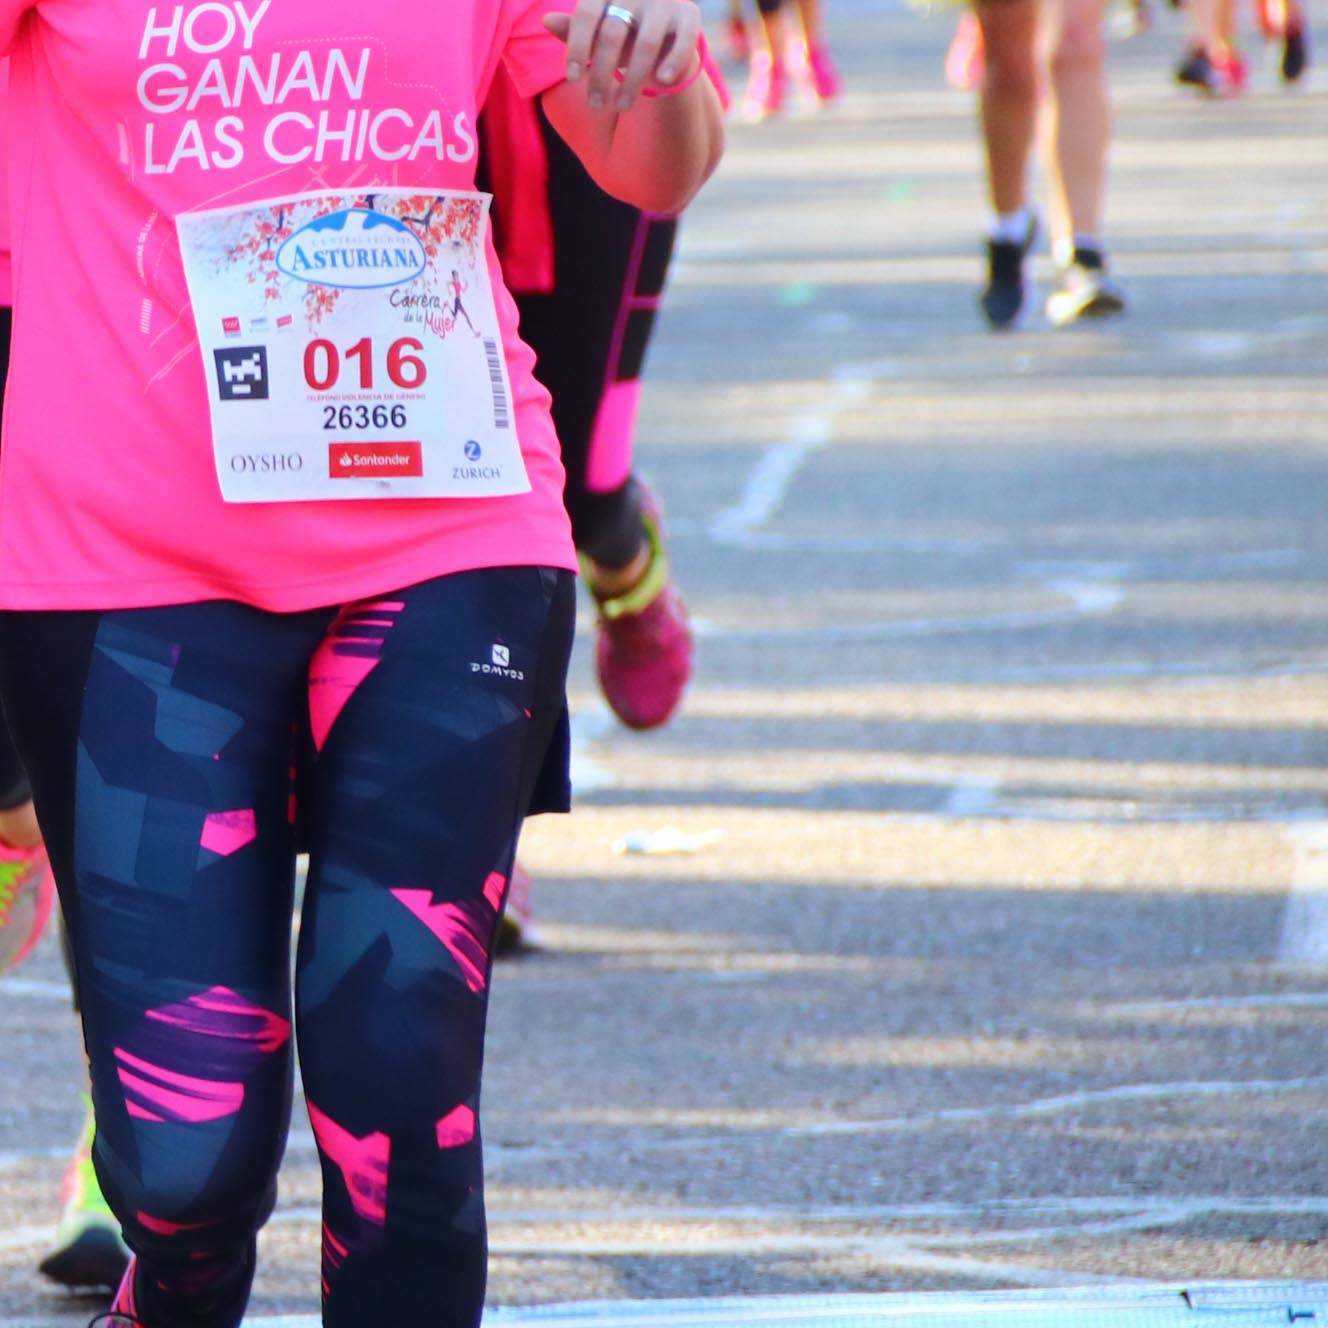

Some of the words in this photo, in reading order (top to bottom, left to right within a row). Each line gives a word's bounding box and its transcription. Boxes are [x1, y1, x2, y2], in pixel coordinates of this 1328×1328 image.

[138, 0, 272, 60] HOY
[136, 47, 371, 114] GANAN
[145, 117, 244, 174] LAS
[263, 108, 477, 164] CHICAS
[293, 244, 419, 272] ASTURIANA
[389, 288, 441, 308] Carrera
[303, 336, 427, 391] 016
[322, 403, 408, 431] 26366
[230, 453, 304, 474] OYSHO
[352, 452, 411, 467] Santander
[452, 466, 501, 480] ZURICH
